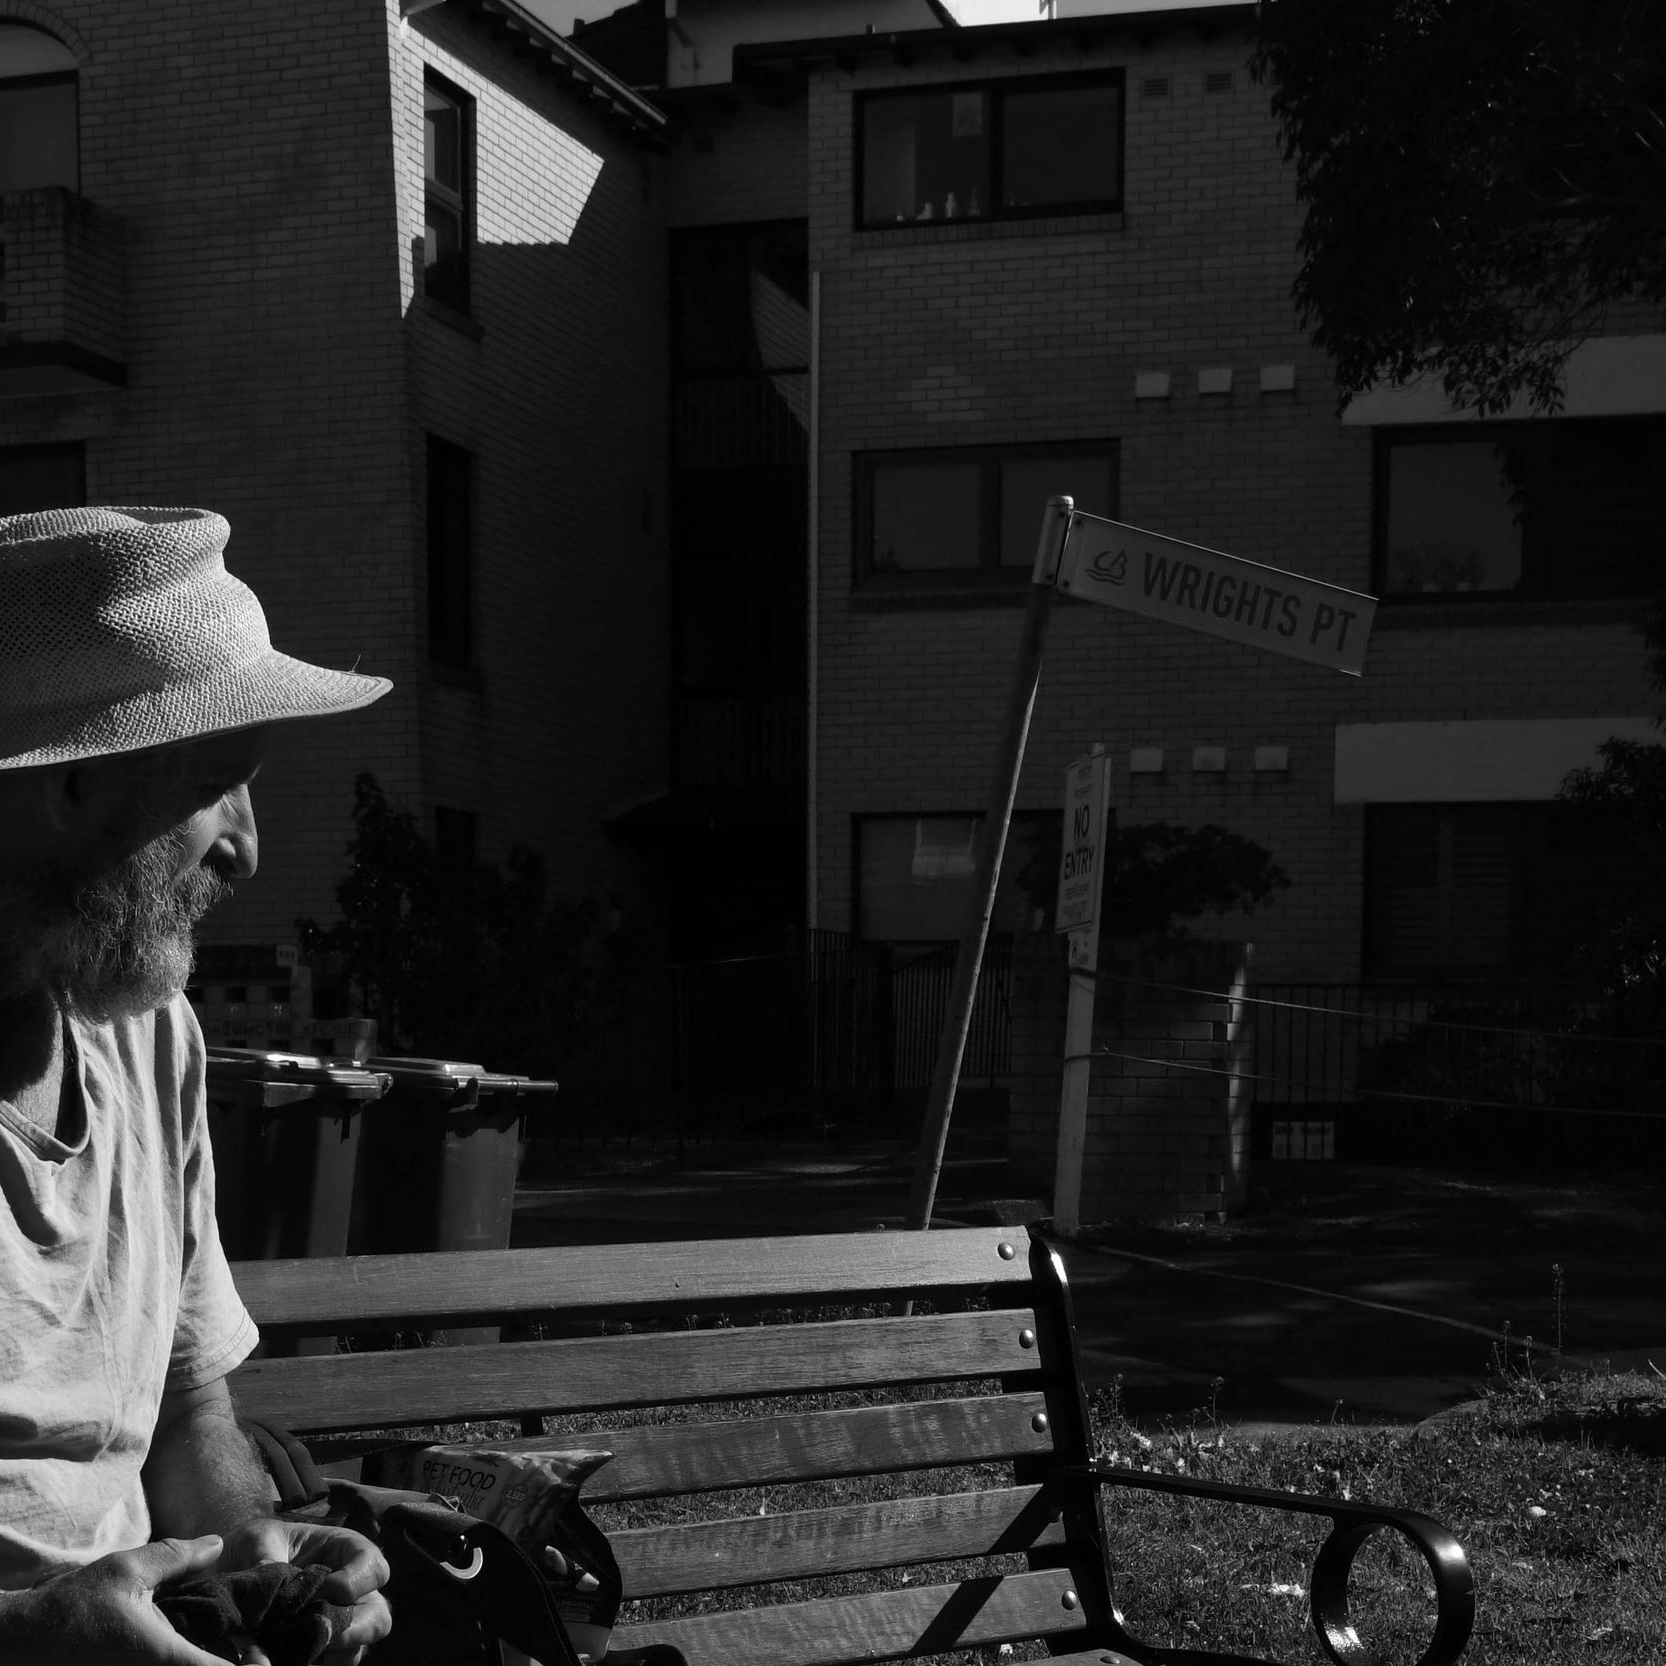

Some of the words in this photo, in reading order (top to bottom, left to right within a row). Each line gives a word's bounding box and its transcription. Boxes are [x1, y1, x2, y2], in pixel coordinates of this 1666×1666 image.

[1142, 551, 1302, 638] WRIGHTS
[1309, 603, 1357, 653] PT
[1073, 804, 1090, 840] NO
[1063, 845, 1096, 881] ENTRY
[422, 1460, 450, 1480] PET
[448, 1466, 497, 1490] FOOD
